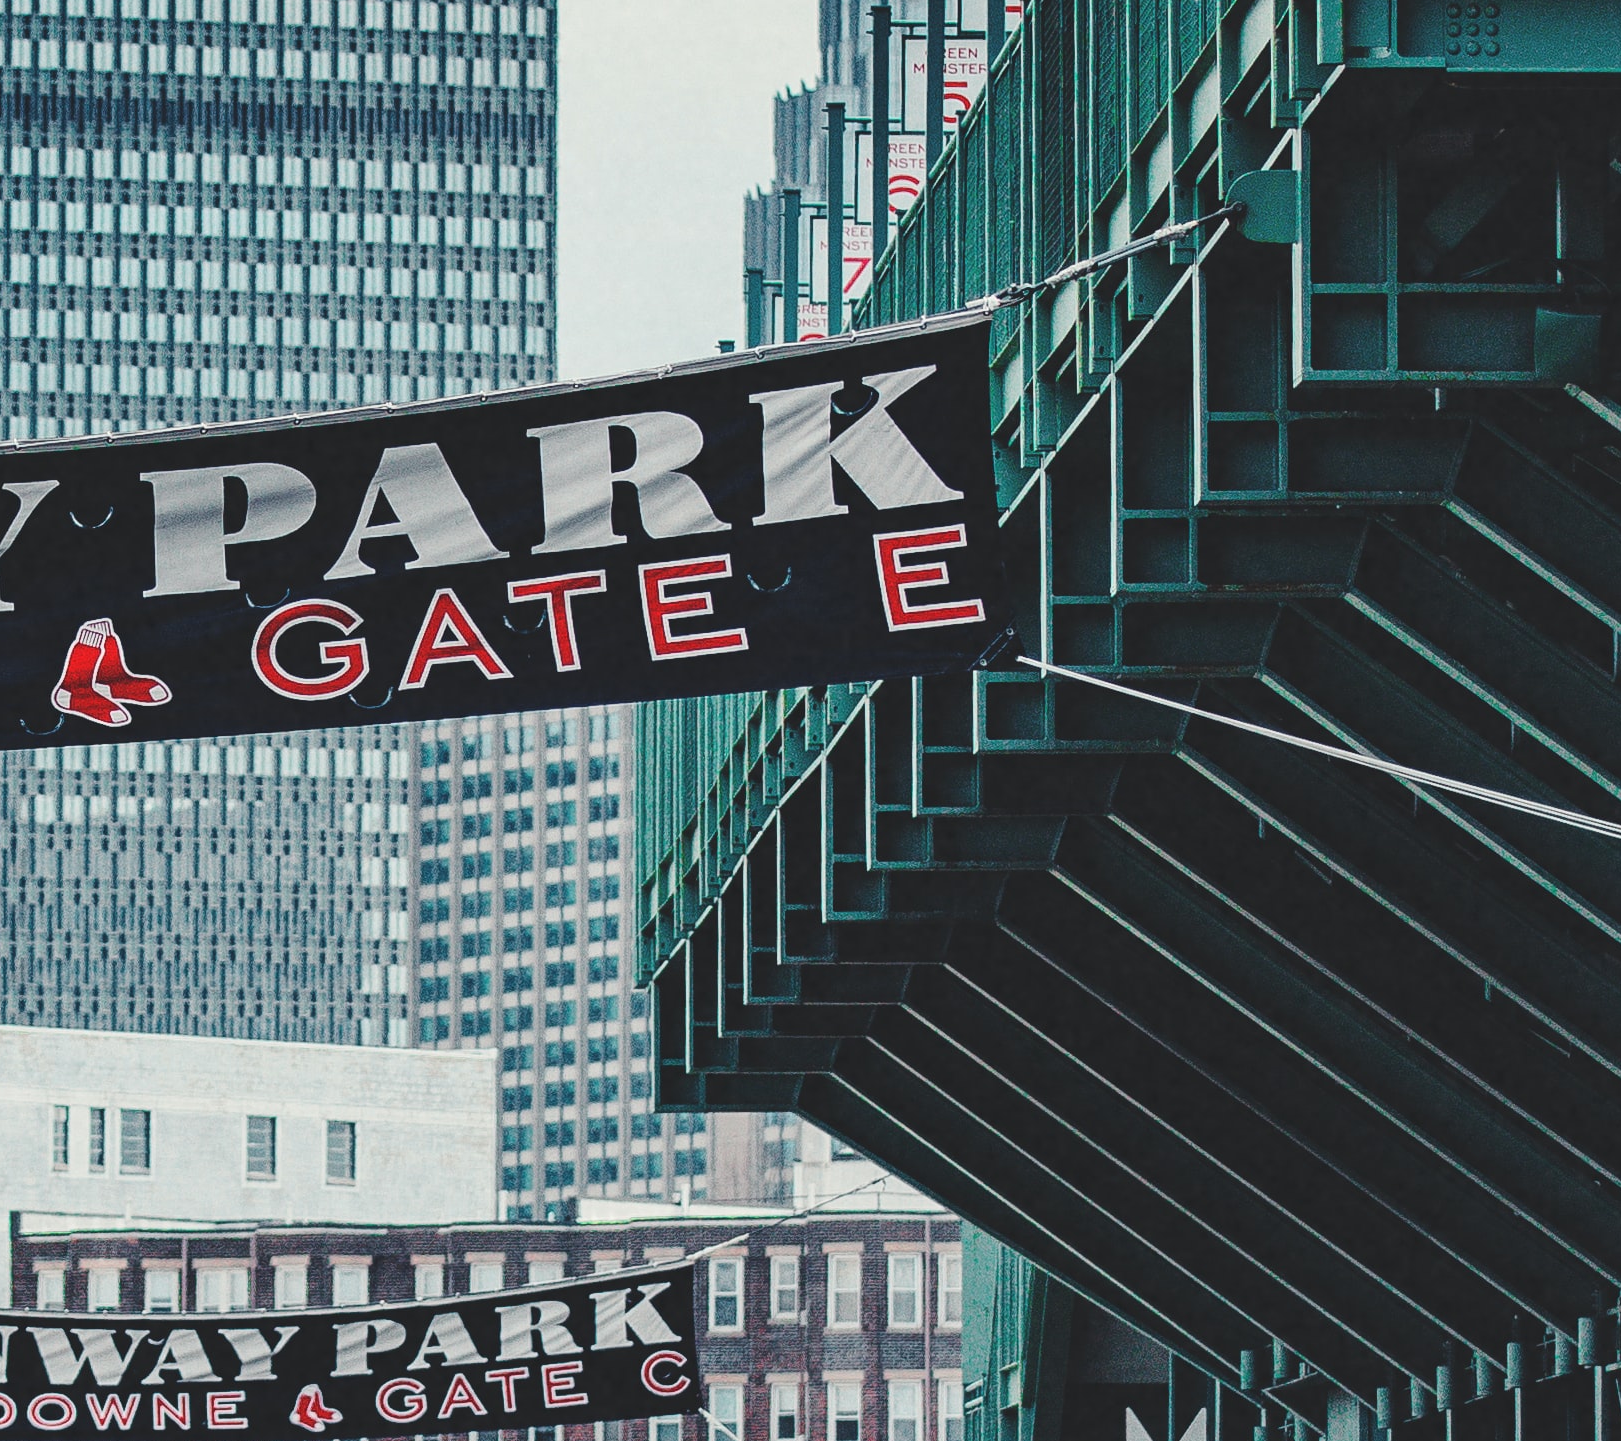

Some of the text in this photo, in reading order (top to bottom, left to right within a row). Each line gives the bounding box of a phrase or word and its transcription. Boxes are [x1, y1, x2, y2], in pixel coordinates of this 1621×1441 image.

[913, 63, 988, 75] MNSTER
[140, 365, 966, 597] PARK
[250, 553, 749, 701] GATE
[873, 523, 985, 634] E
[328, 1281, 684, 1378] PARK
[374, 1361, 590, 1425] GATE
[640, 1350, 691, 1398] C
